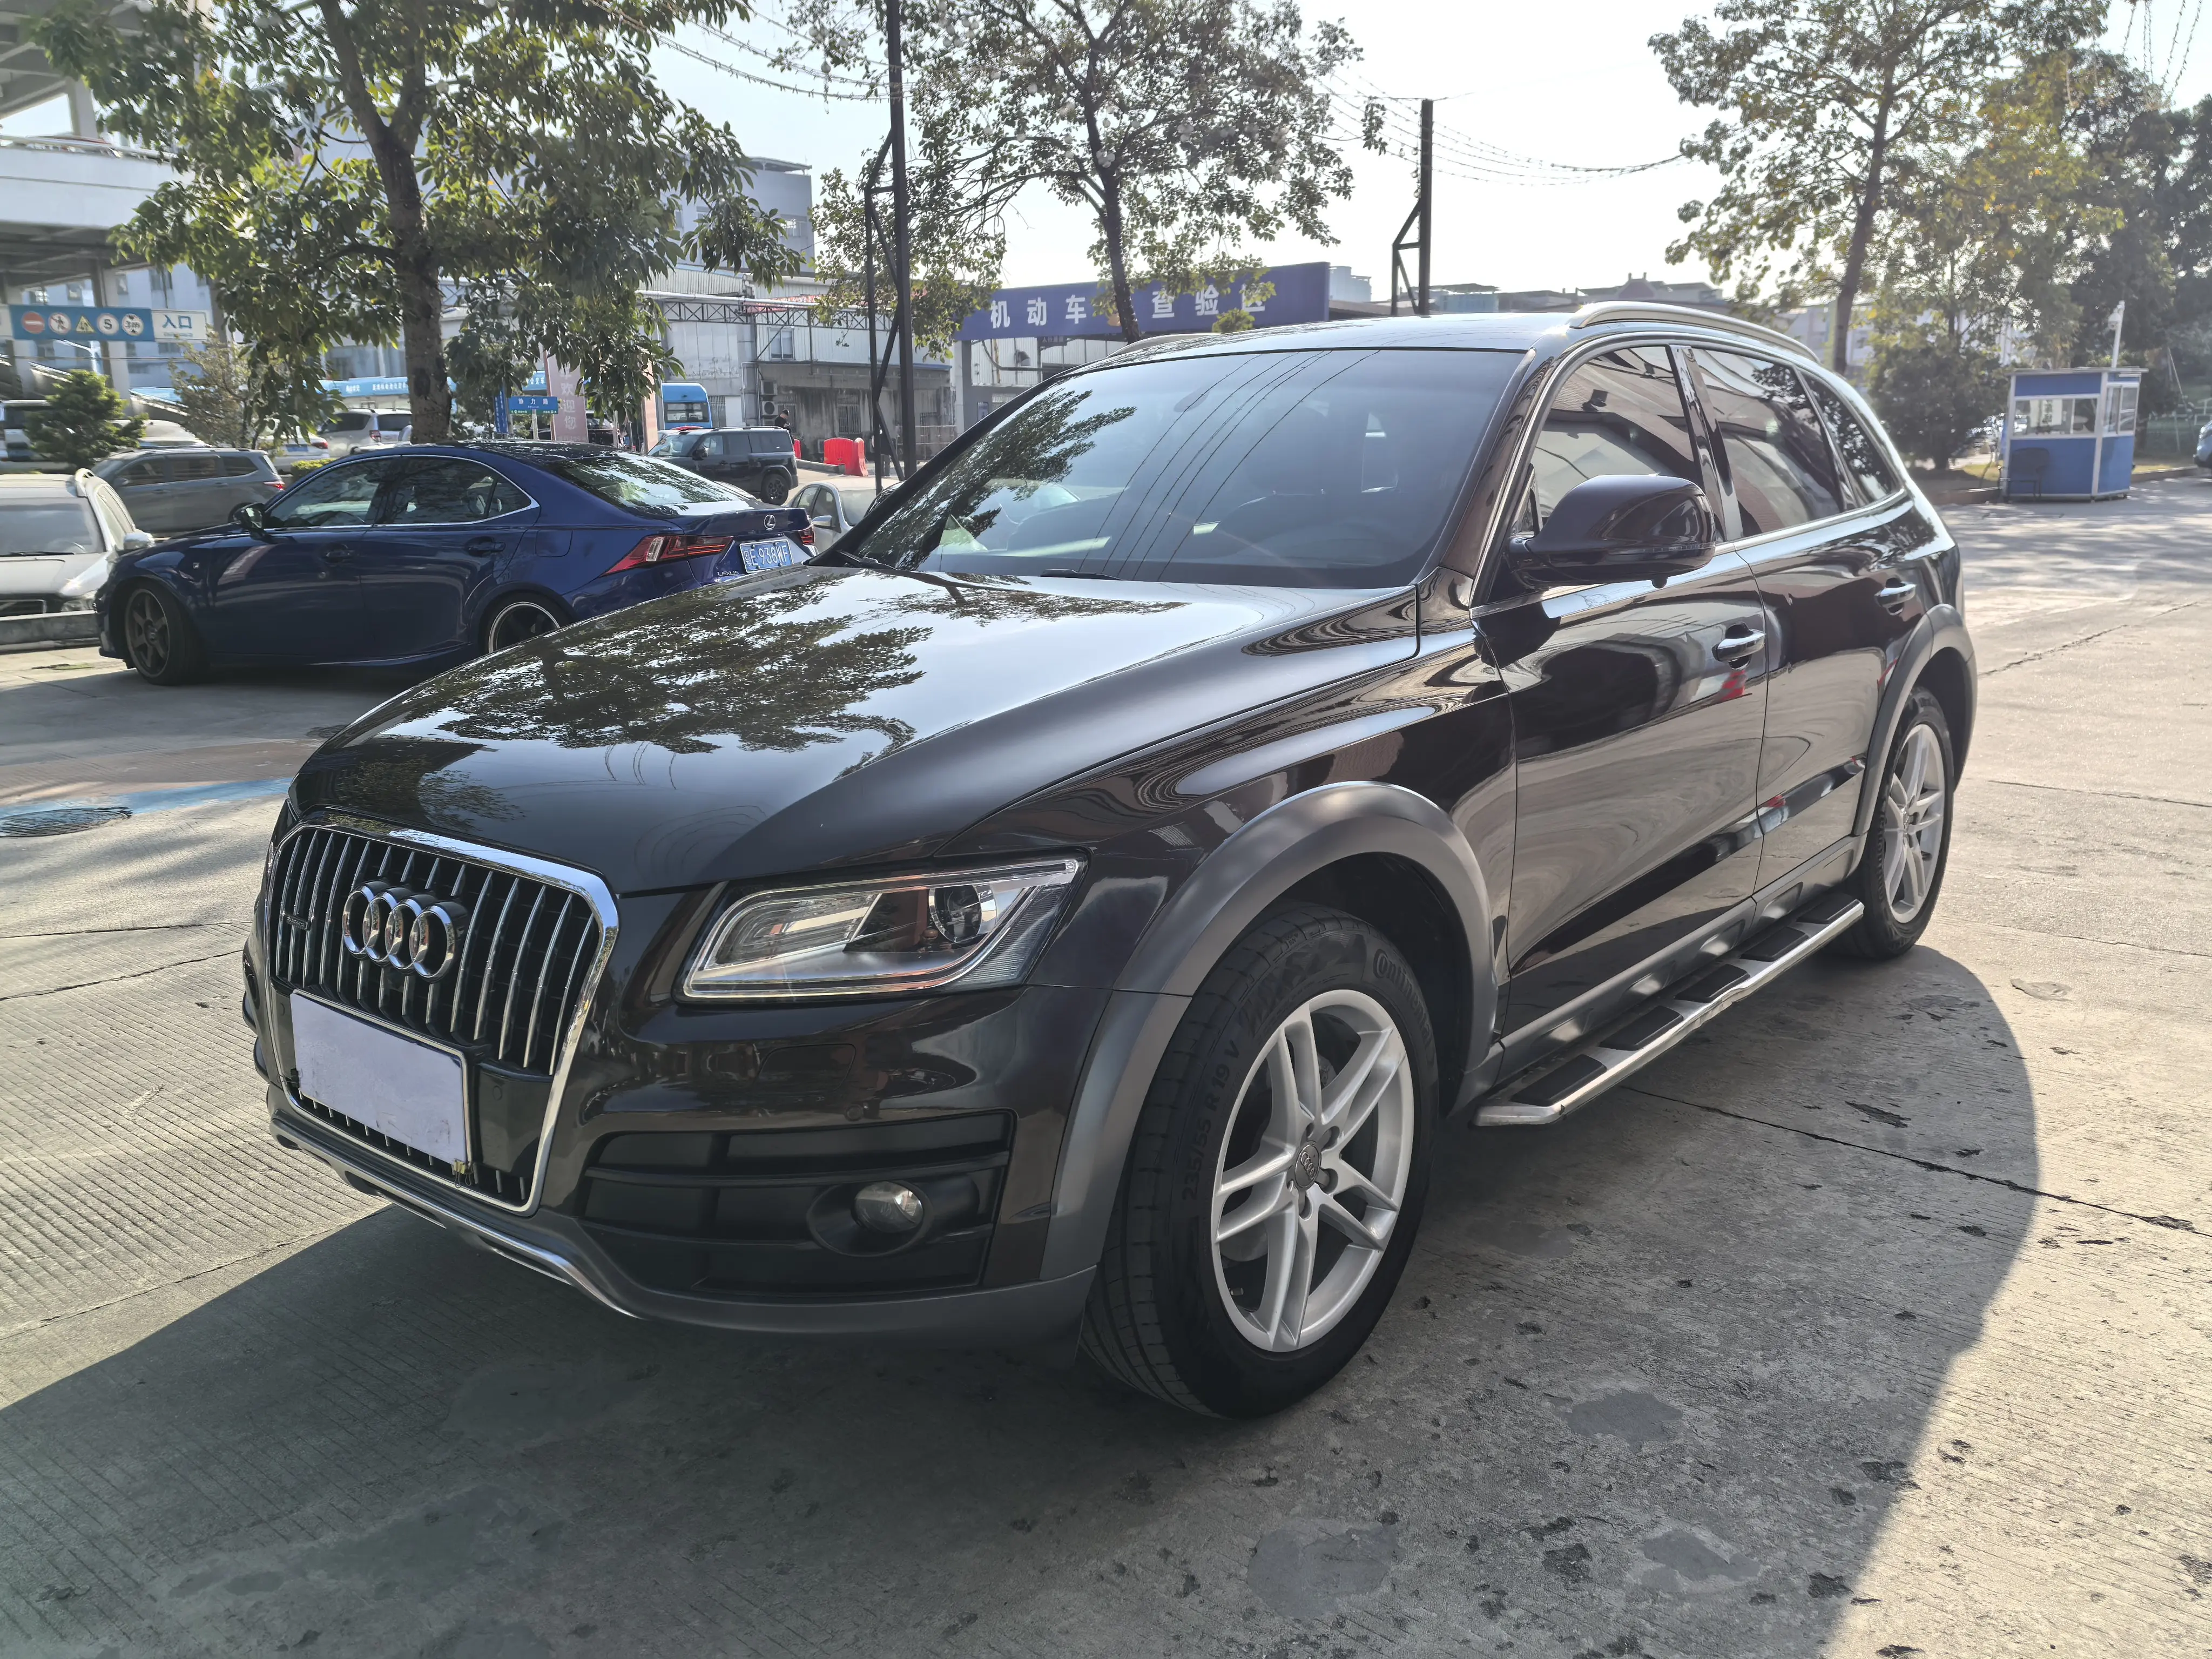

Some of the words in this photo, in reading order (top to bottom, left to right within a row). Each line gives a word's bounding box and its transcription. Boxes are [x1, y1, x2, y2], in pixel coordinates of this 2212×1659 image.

[163, 314, 192, 328] 入口
[1373, 948, 1442, 1049] Continental
[1223, 1039, 1240, 1058] V
[1211, 1063, 1230, 1089] 19
[1204, 1092, 1220, 1112] R
[1182, 1118, 1211, 1201] 235/55
